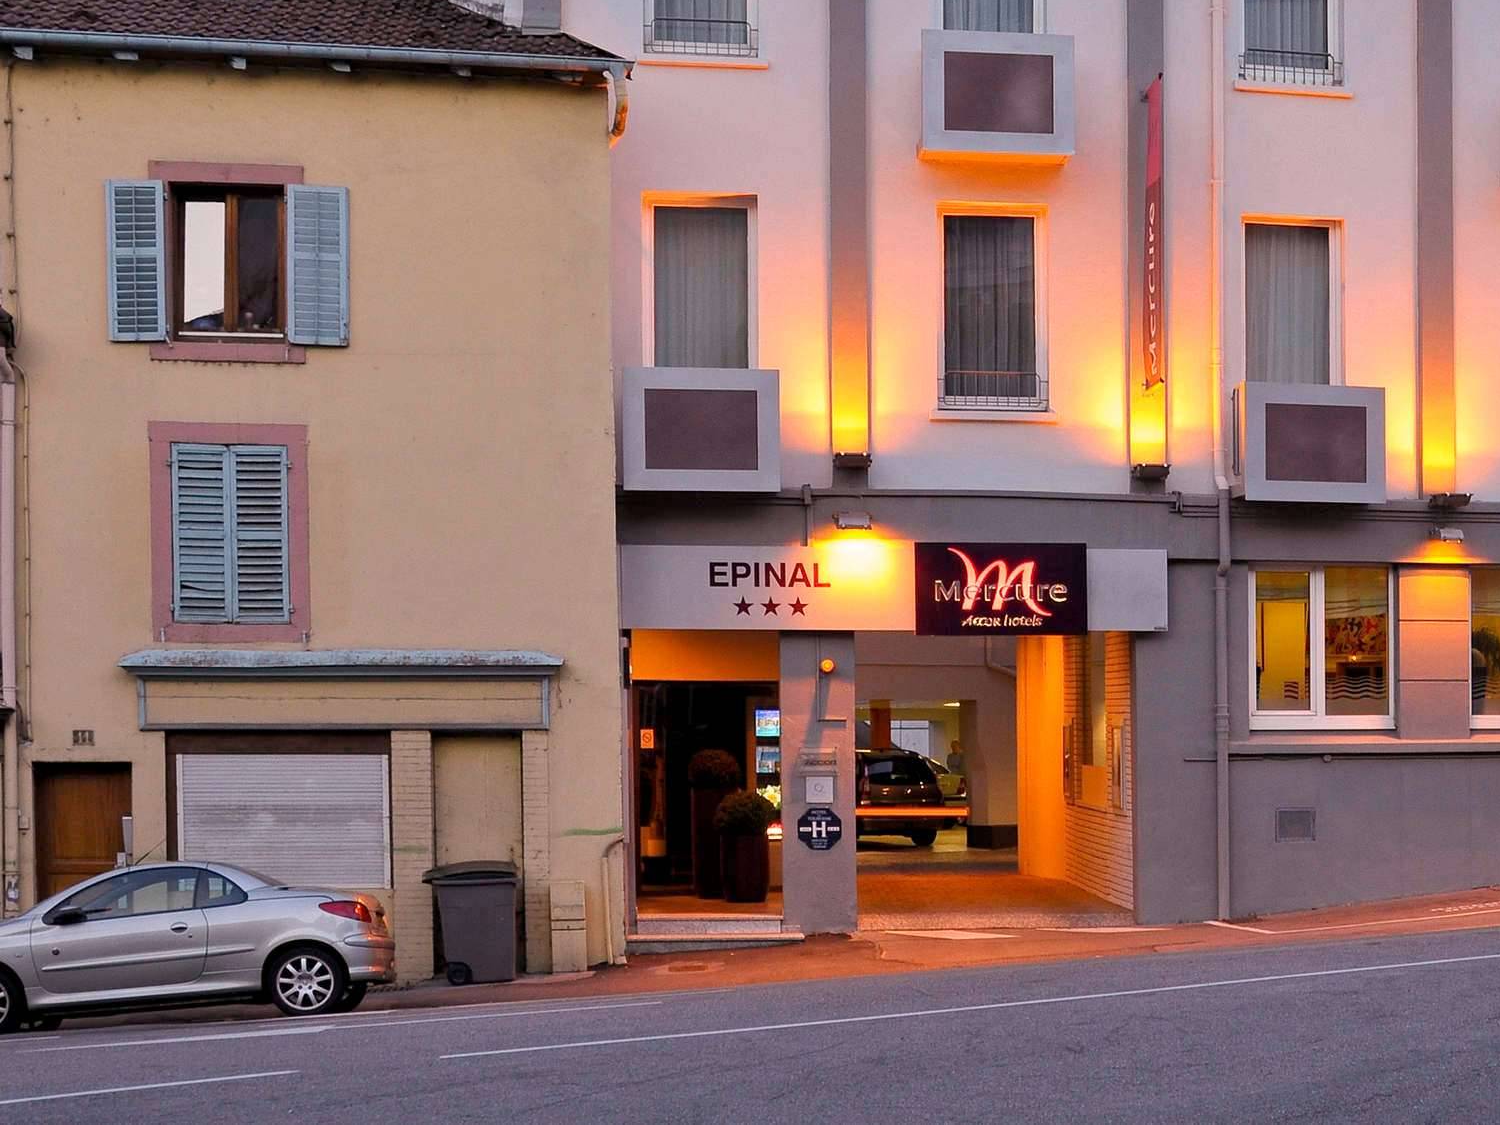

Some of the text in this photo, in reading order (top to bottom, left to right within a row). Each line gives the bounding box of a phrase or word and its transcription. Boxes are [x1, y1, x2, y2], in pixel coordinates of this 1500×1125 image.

[709, 562, 831, 588] EPINAL
[934, 580, 1068, 603] Mercure
[1003, 614, 1043, 627] hotels
[812, 821, 827, 838] H
